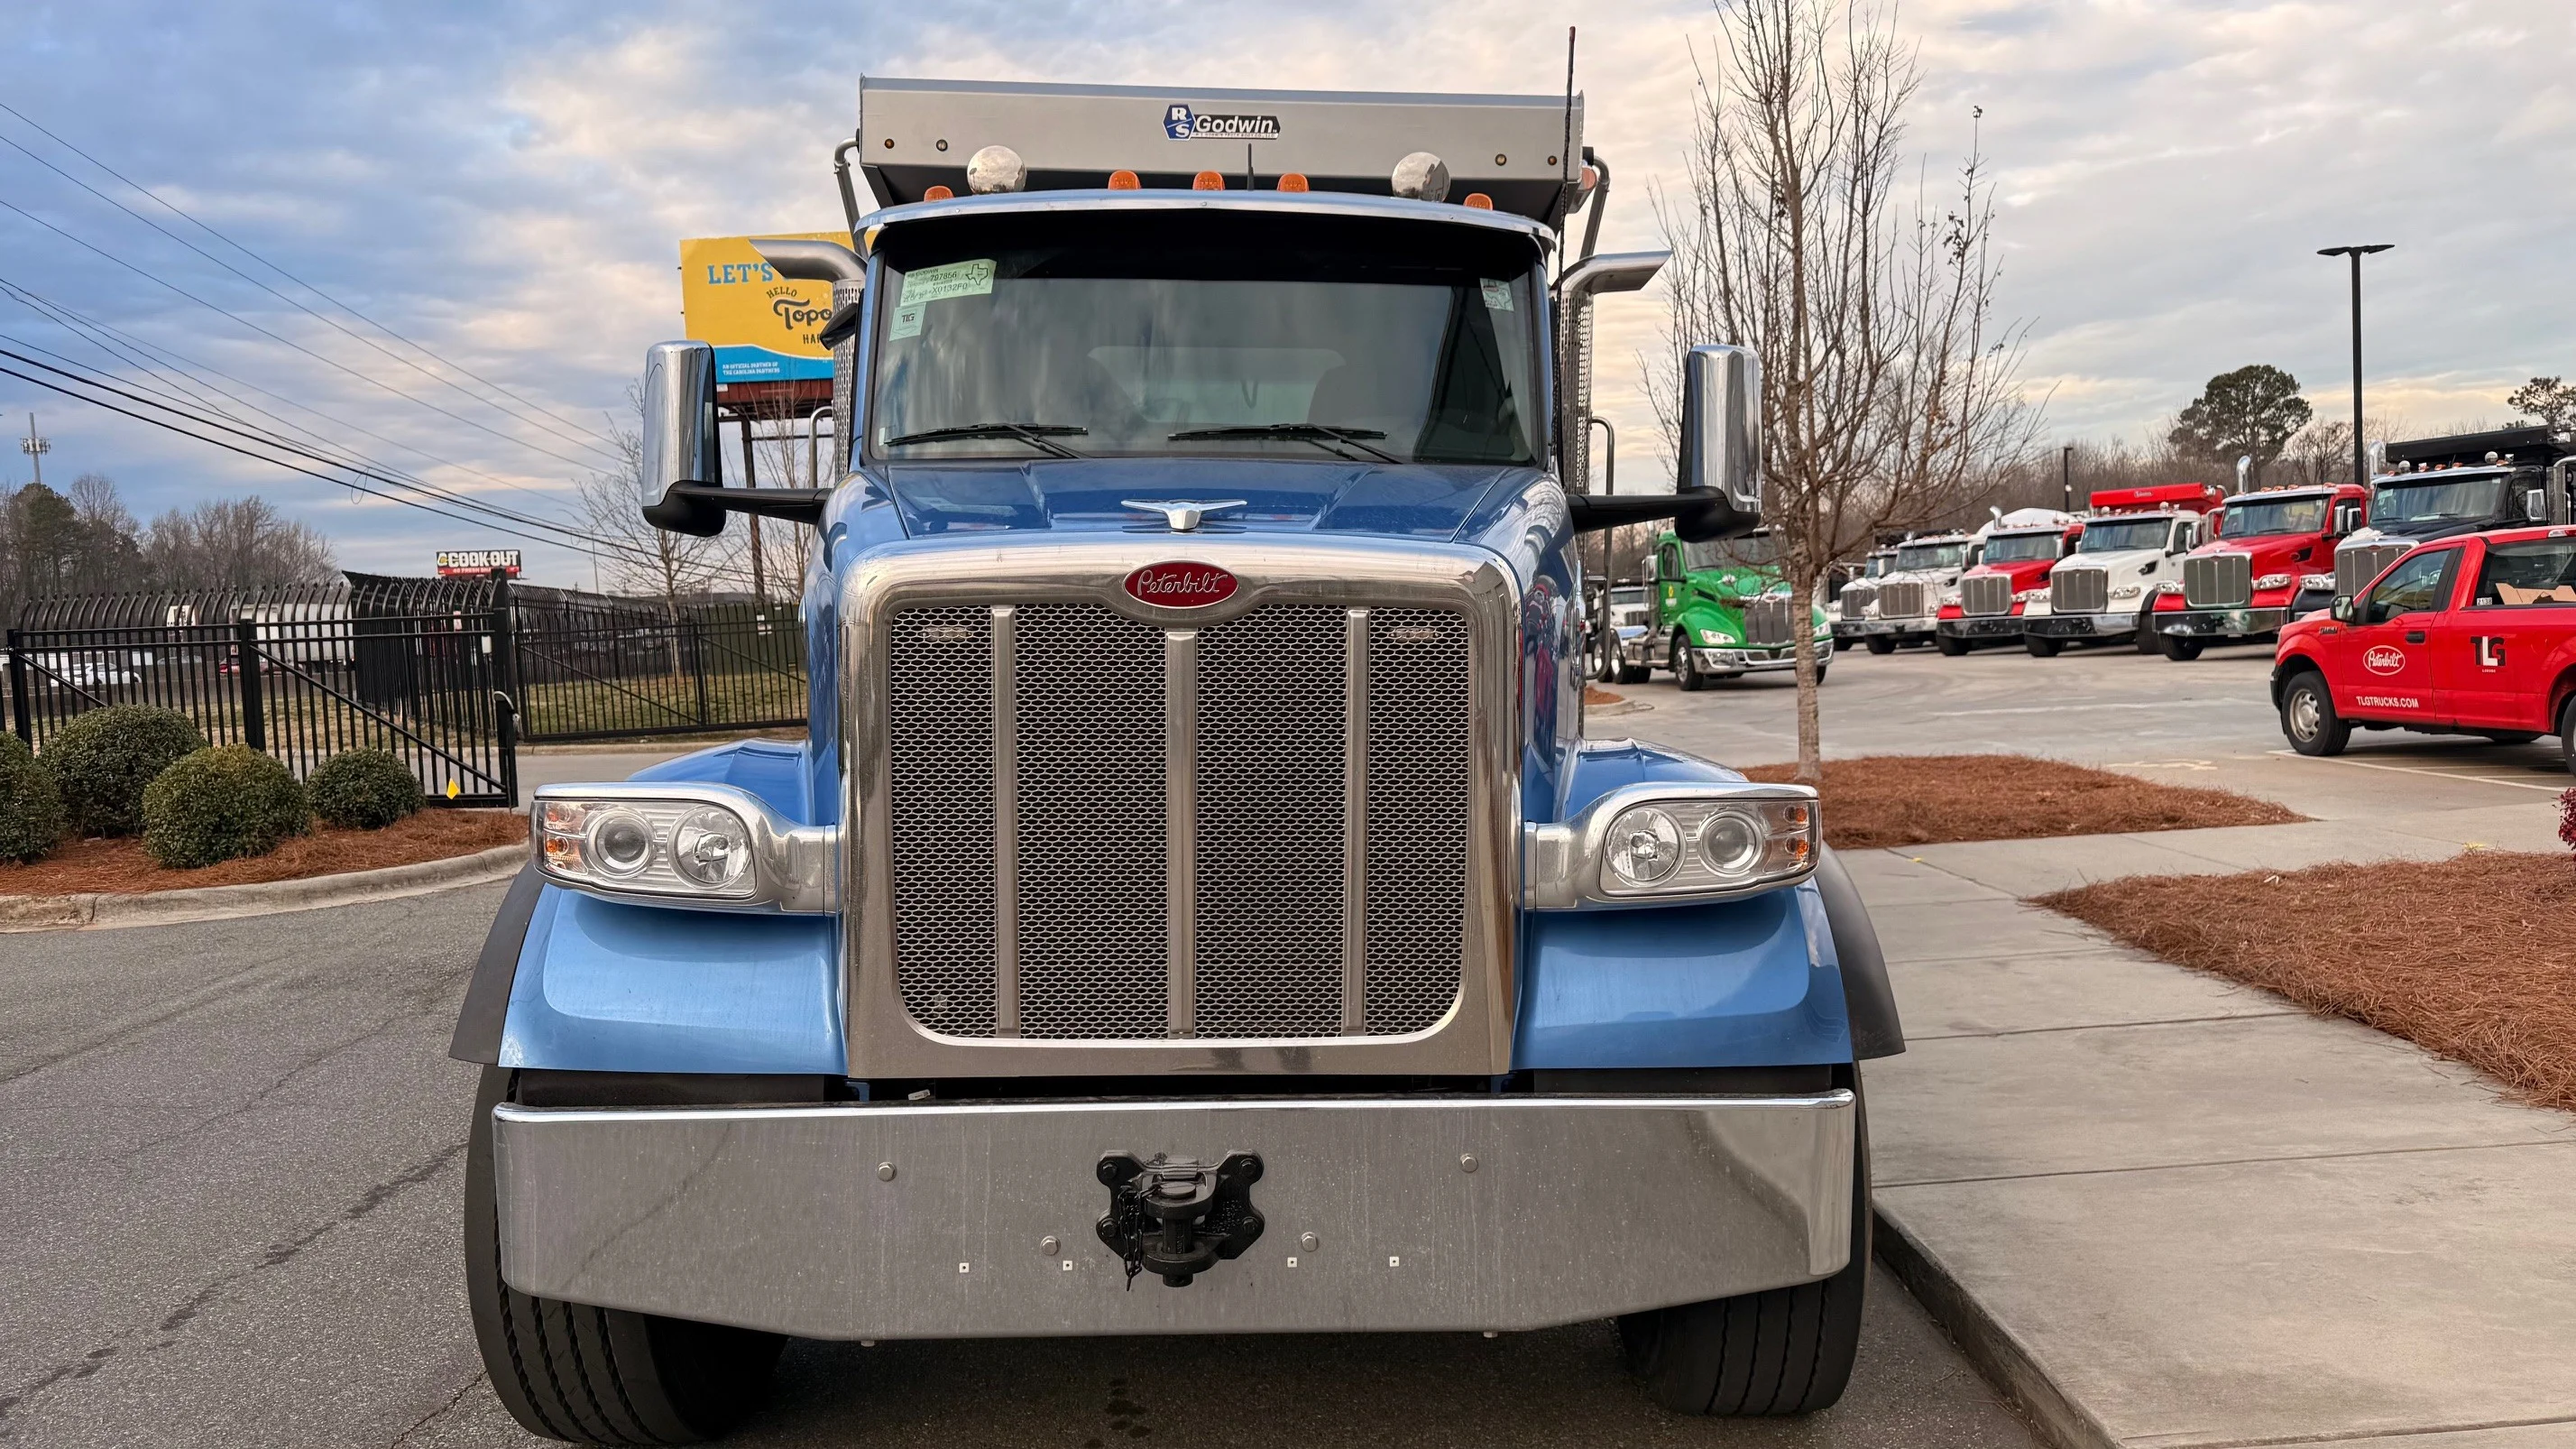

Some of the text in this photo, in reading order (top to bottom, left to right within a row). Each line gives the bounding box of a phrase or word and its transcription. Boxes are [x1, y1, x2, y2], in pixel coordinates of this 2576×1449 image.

[1196, 115, 1274, 133] Godwin
[707, 262, 773, 284] LET'S
[766, 286, 797, 299] HELLO
[773, 299, 833, 330] Topo
[1136, 569, 1228, 596] Peterbilt
[2368, 650, 2404, 668] Peterbilt
[2470, 635, 2507, 667] TLG
[2356, 696, 2419, 708] TLGTRUCKS.COM
